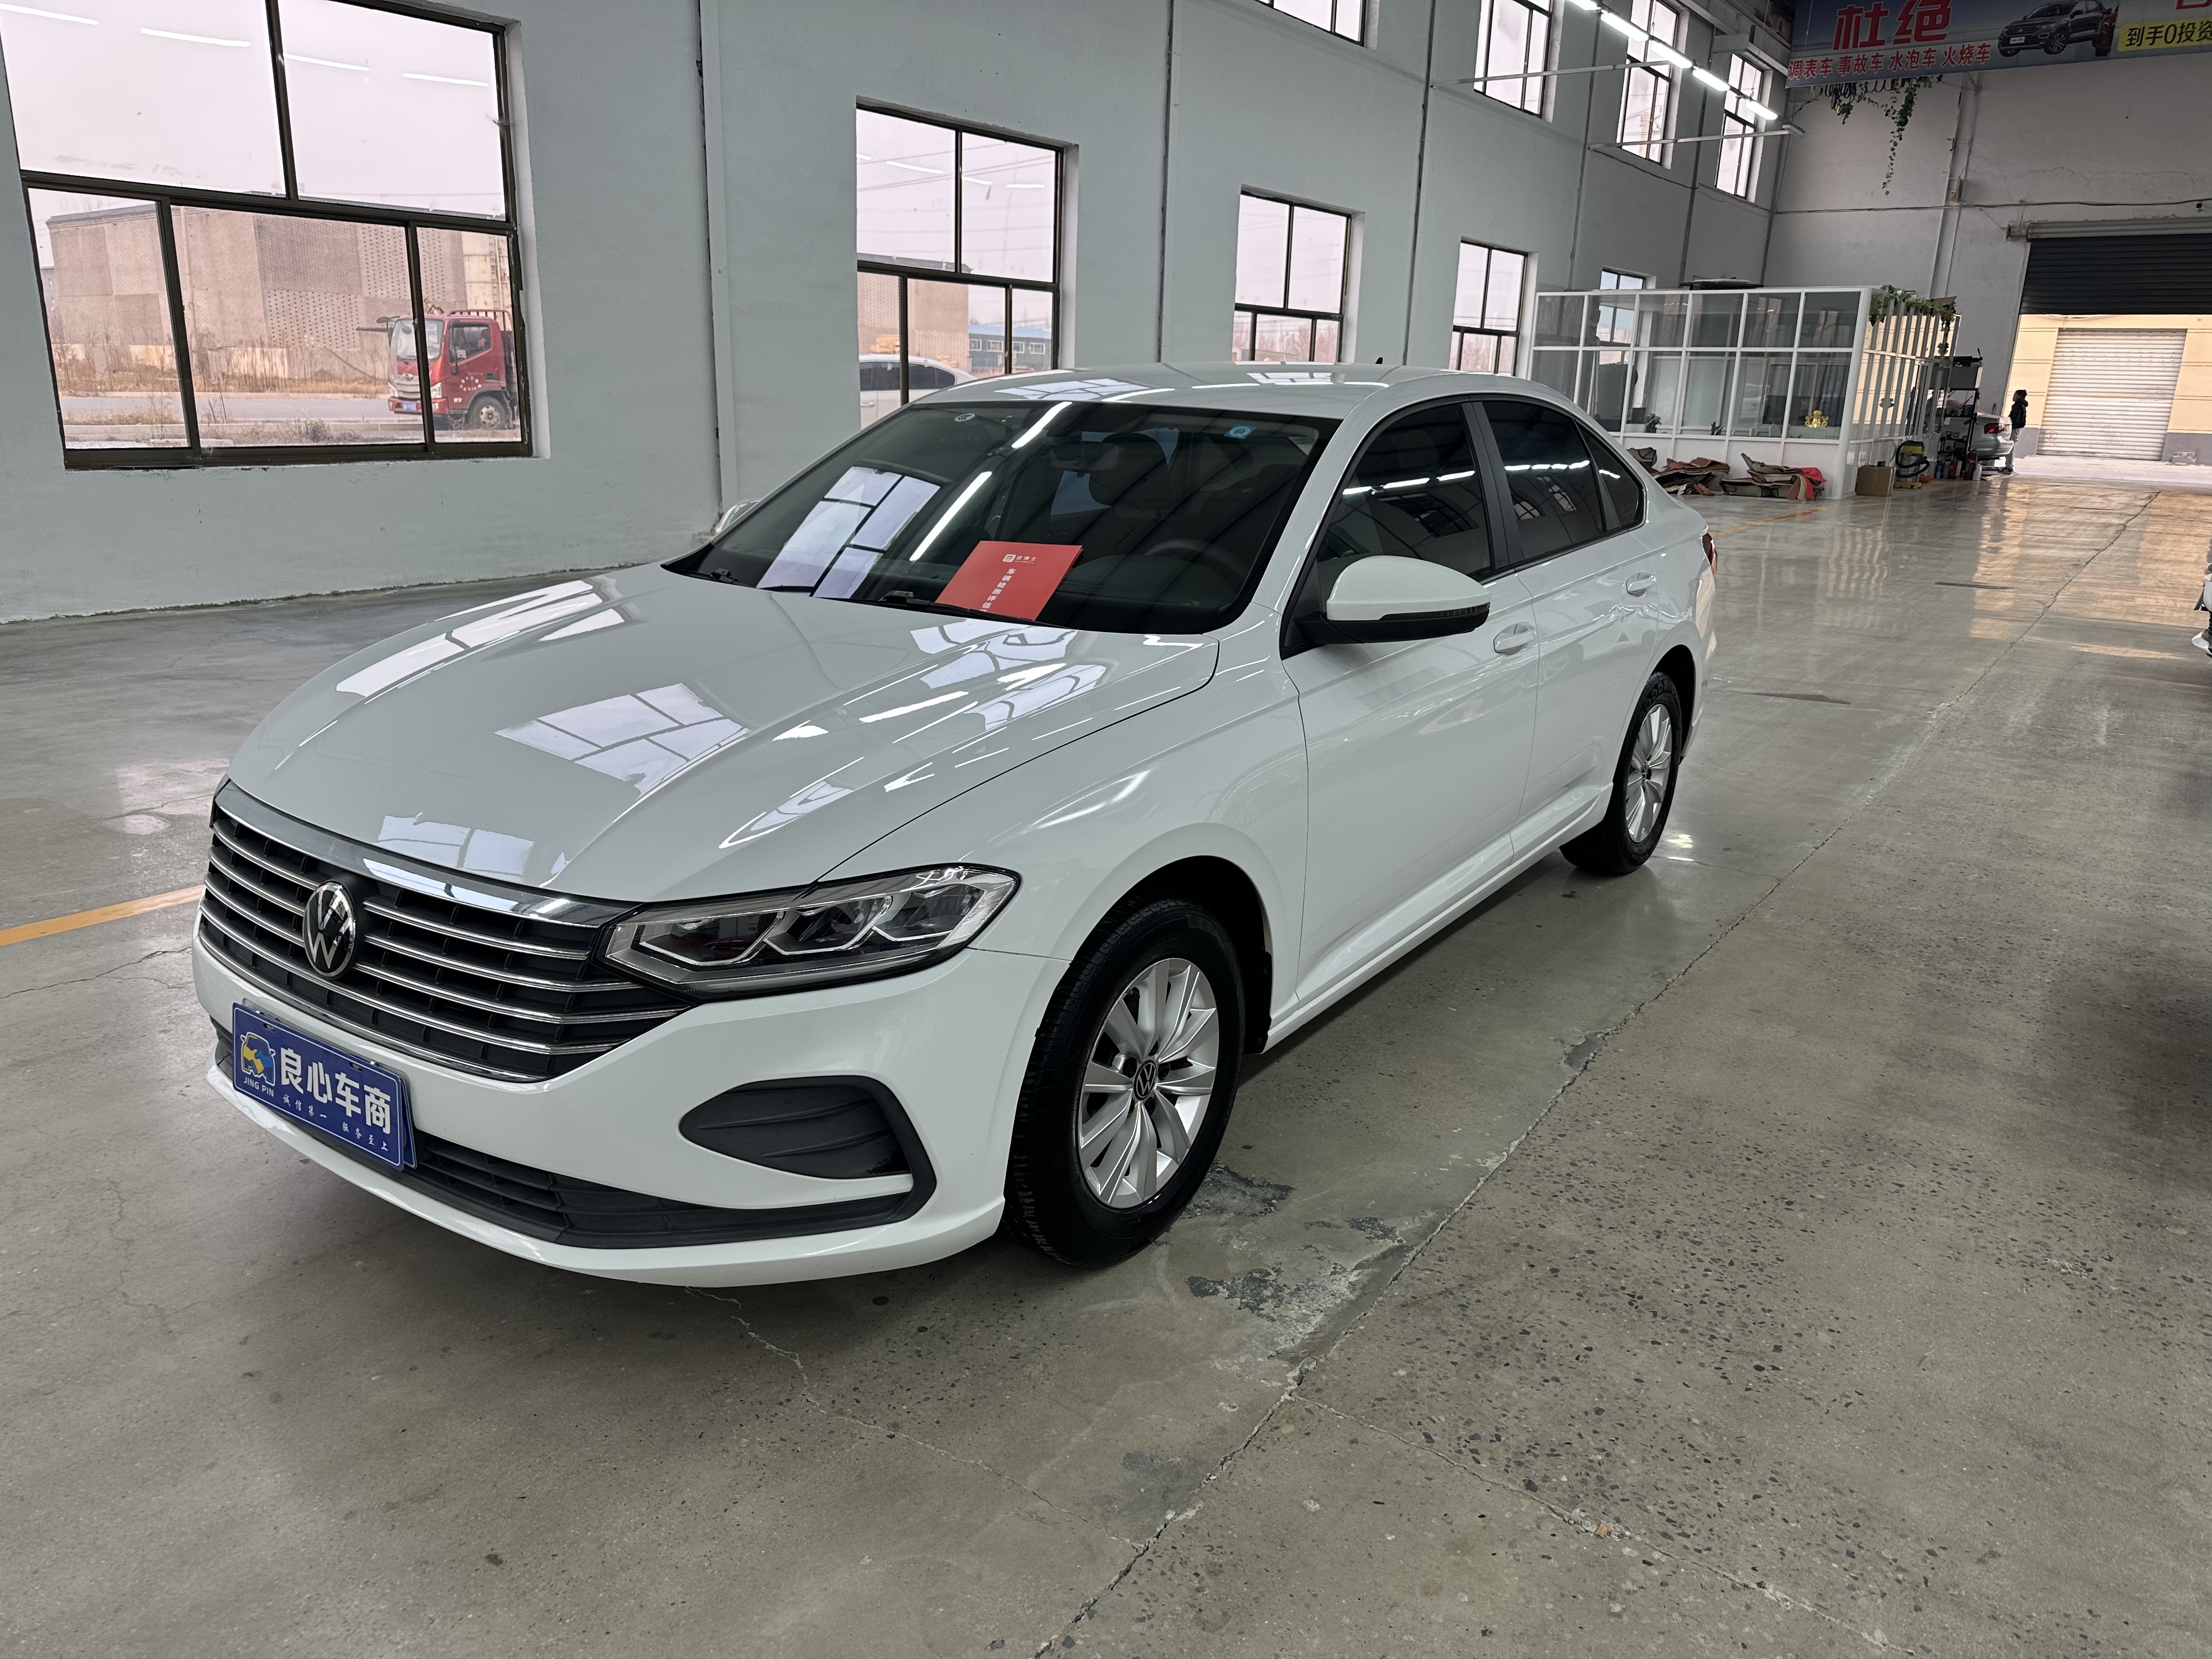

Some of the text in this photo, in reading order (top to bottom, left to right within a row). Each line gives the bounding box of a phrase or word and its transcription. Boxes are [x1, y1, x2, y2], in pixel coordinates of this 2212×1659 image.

[1833, 0, 1951, 50] 杜绝
[2125, 20, 2212, 47] 到手0投资
[1788, 43, 1991, 80] 调表车 事故车 水泡车 火烧车
[244, 1076, 274, 1097] JING PIN
[280, 1047, 391, 1135] 良心车商
[283, 1093, 388, 1152] 诚信第一 服务至上
